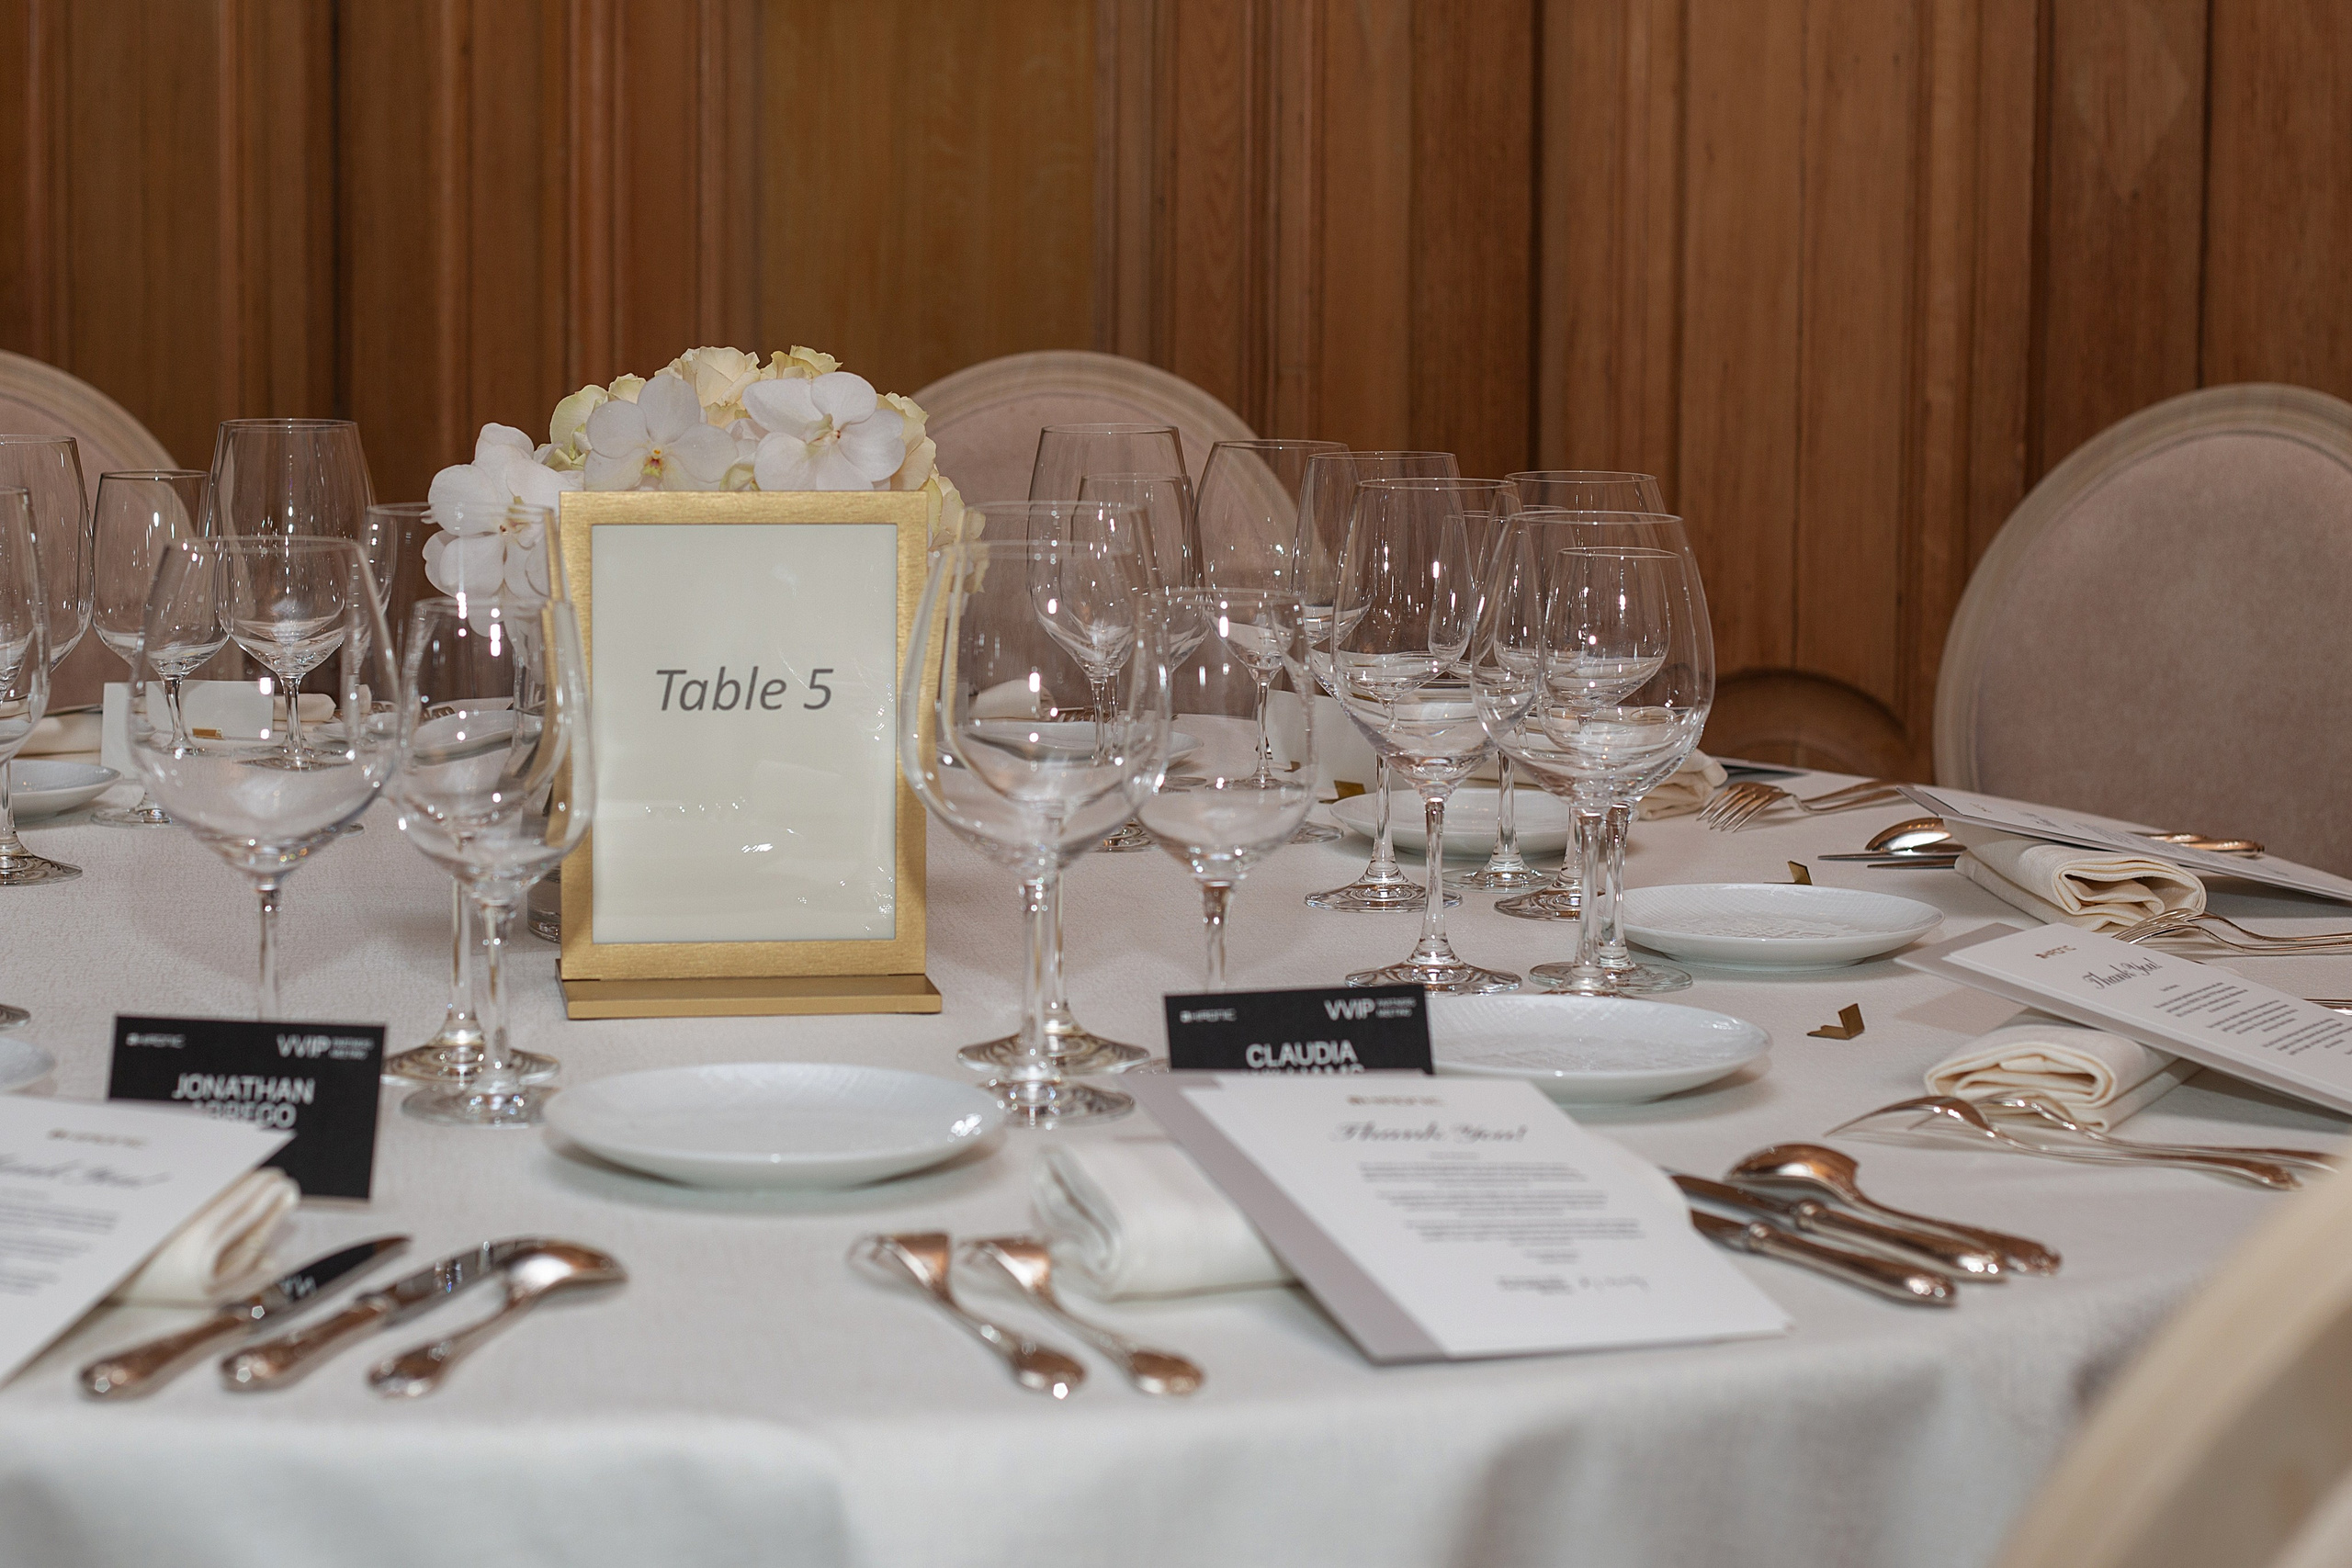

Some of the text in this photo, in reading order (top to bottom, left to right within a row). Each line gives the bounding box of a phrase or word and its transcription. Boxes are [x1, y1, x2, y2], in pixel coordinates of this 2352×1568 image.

[656, 666, 834, 711] Table 5
[2082, 957, 2163, 989] Thank You!
[1245, 1039, 1359, 1068] CLAUDIA
[171, 1072, 316, 1105] JONATHAN
